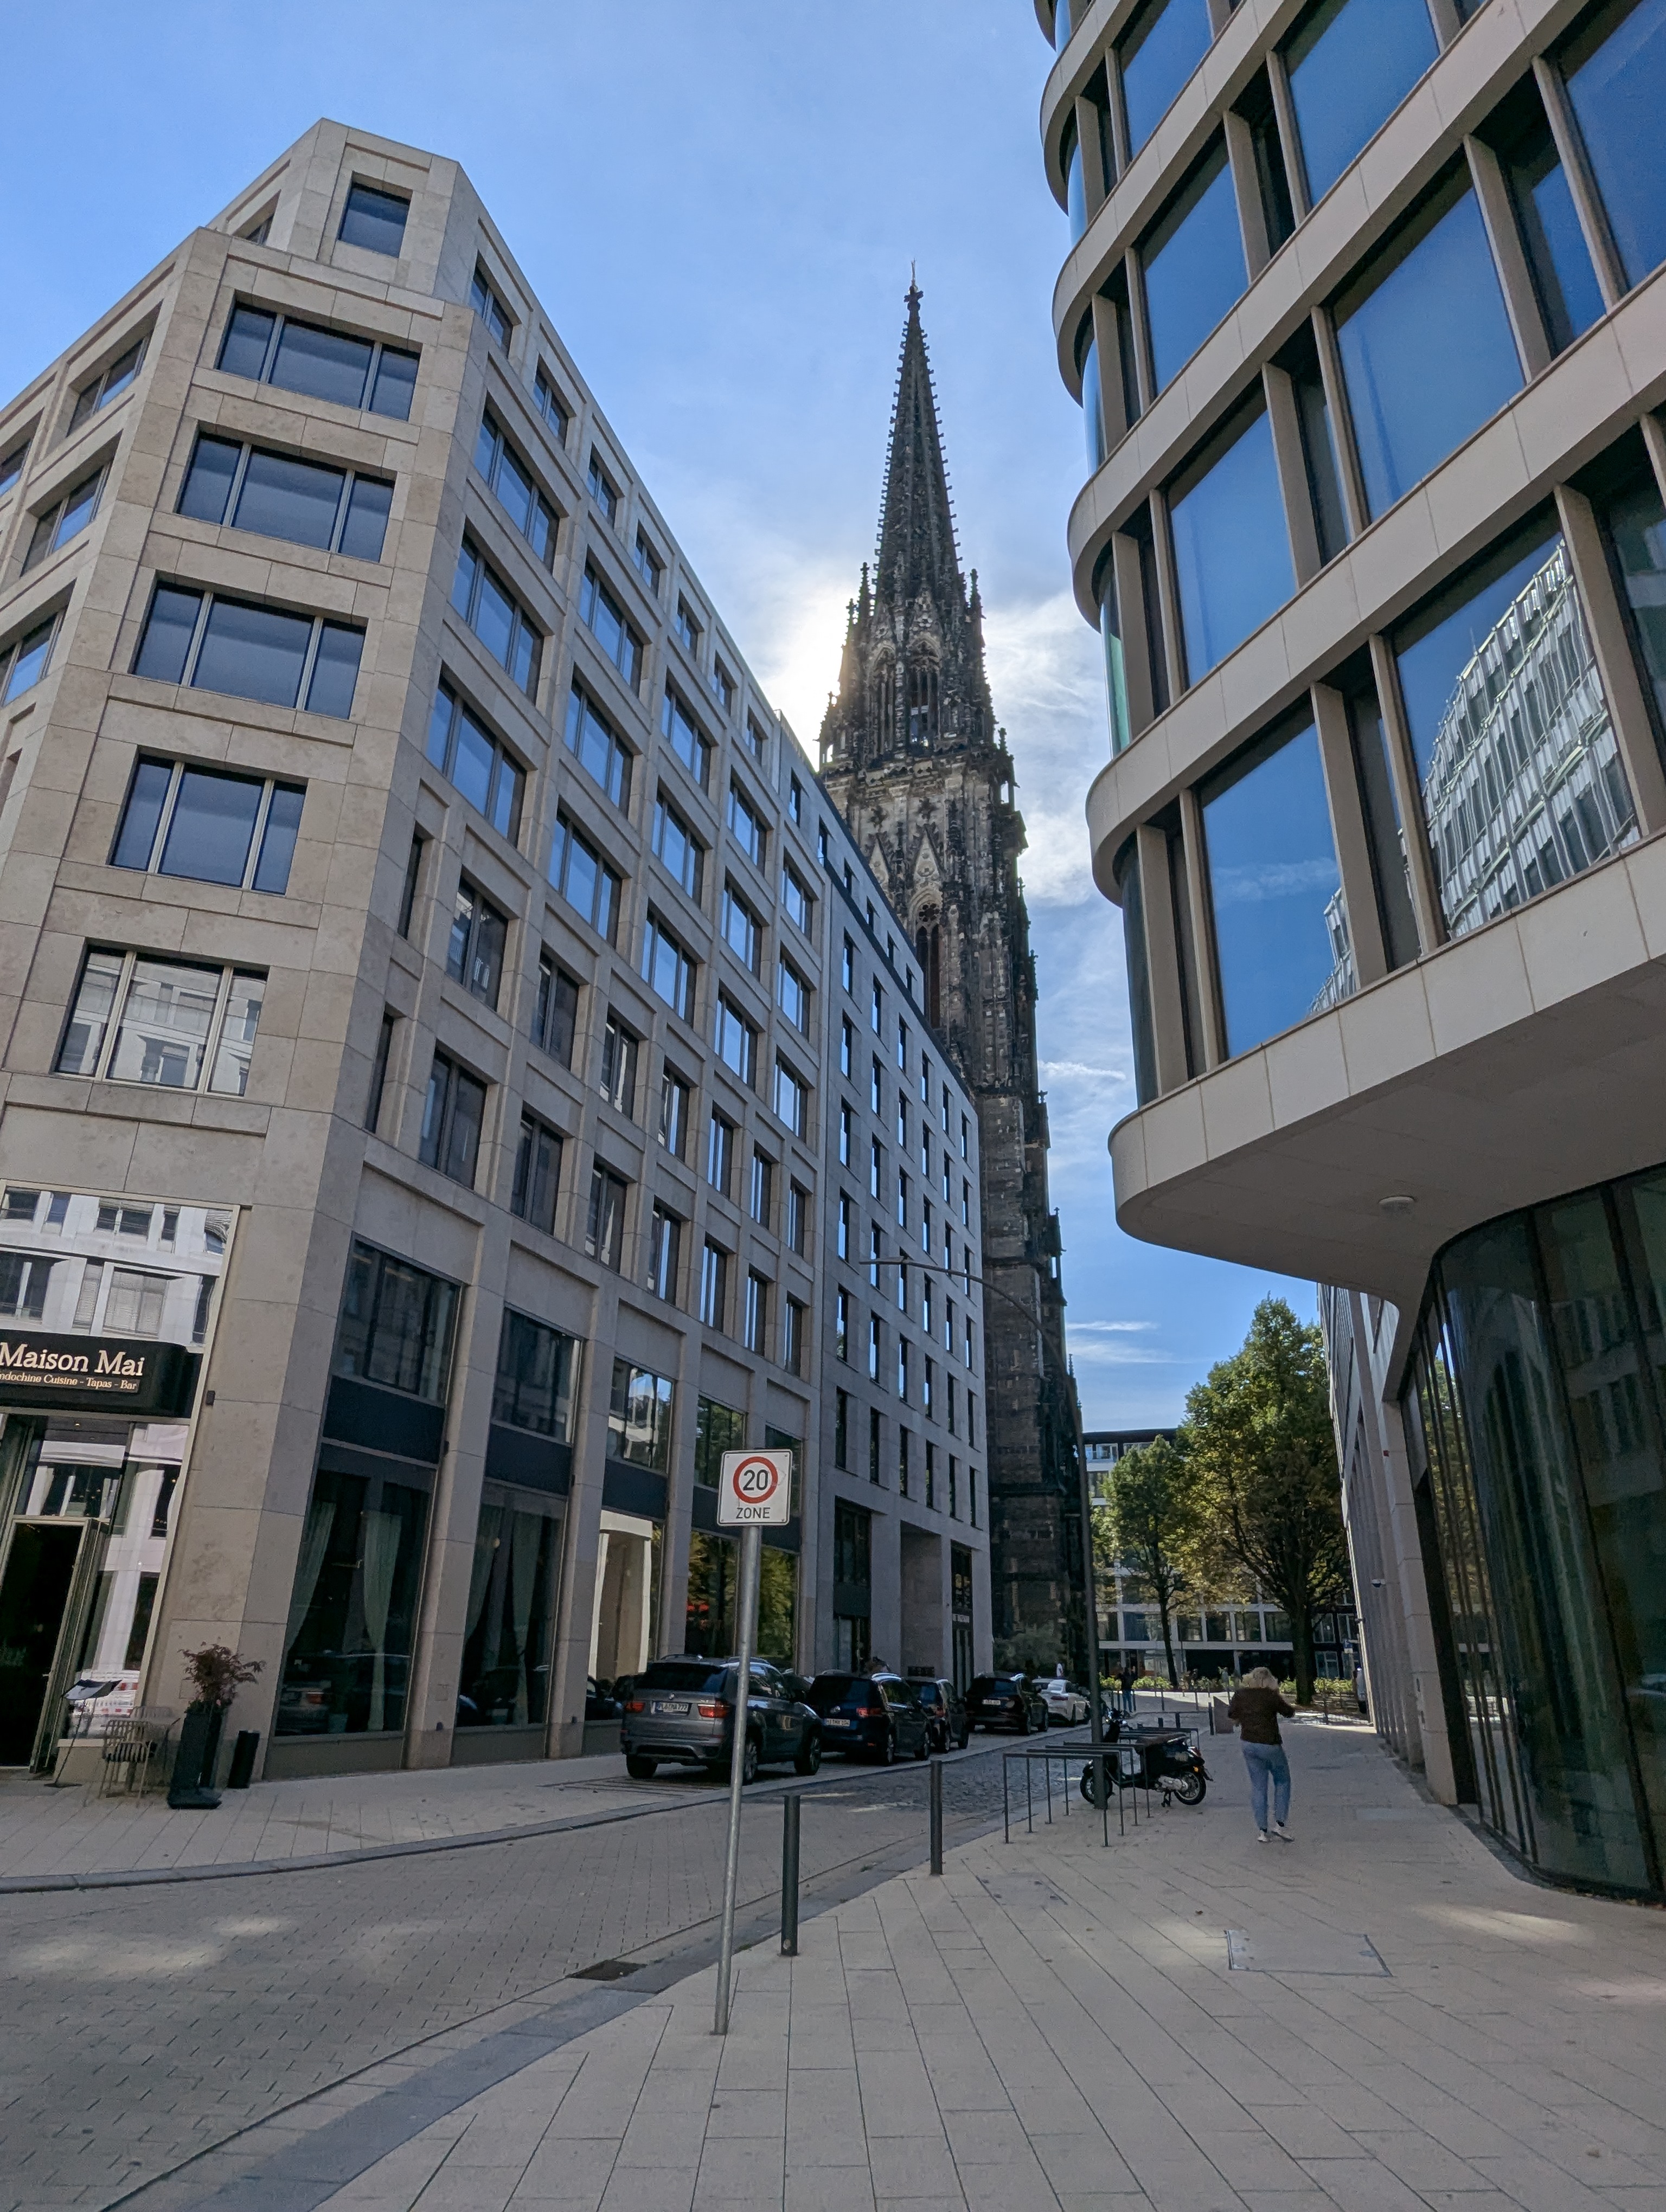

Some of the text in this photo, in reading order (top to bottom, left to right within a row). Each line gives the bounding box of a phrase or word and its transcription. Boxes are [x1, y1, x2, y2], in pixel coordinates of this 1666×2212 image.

[0, 1342, 145, 1376] Maison Mai
[0, 1371, 42, 1383] ndochine
[43, 1374, 78, 1386] Cuisine
[86, 1377, 112, 1389] Tapas
[120, 1380, 137, 1390] Bar
[743, 1469, 768, 1491] 20
[735, 1507, 771, 1519] ZONE
